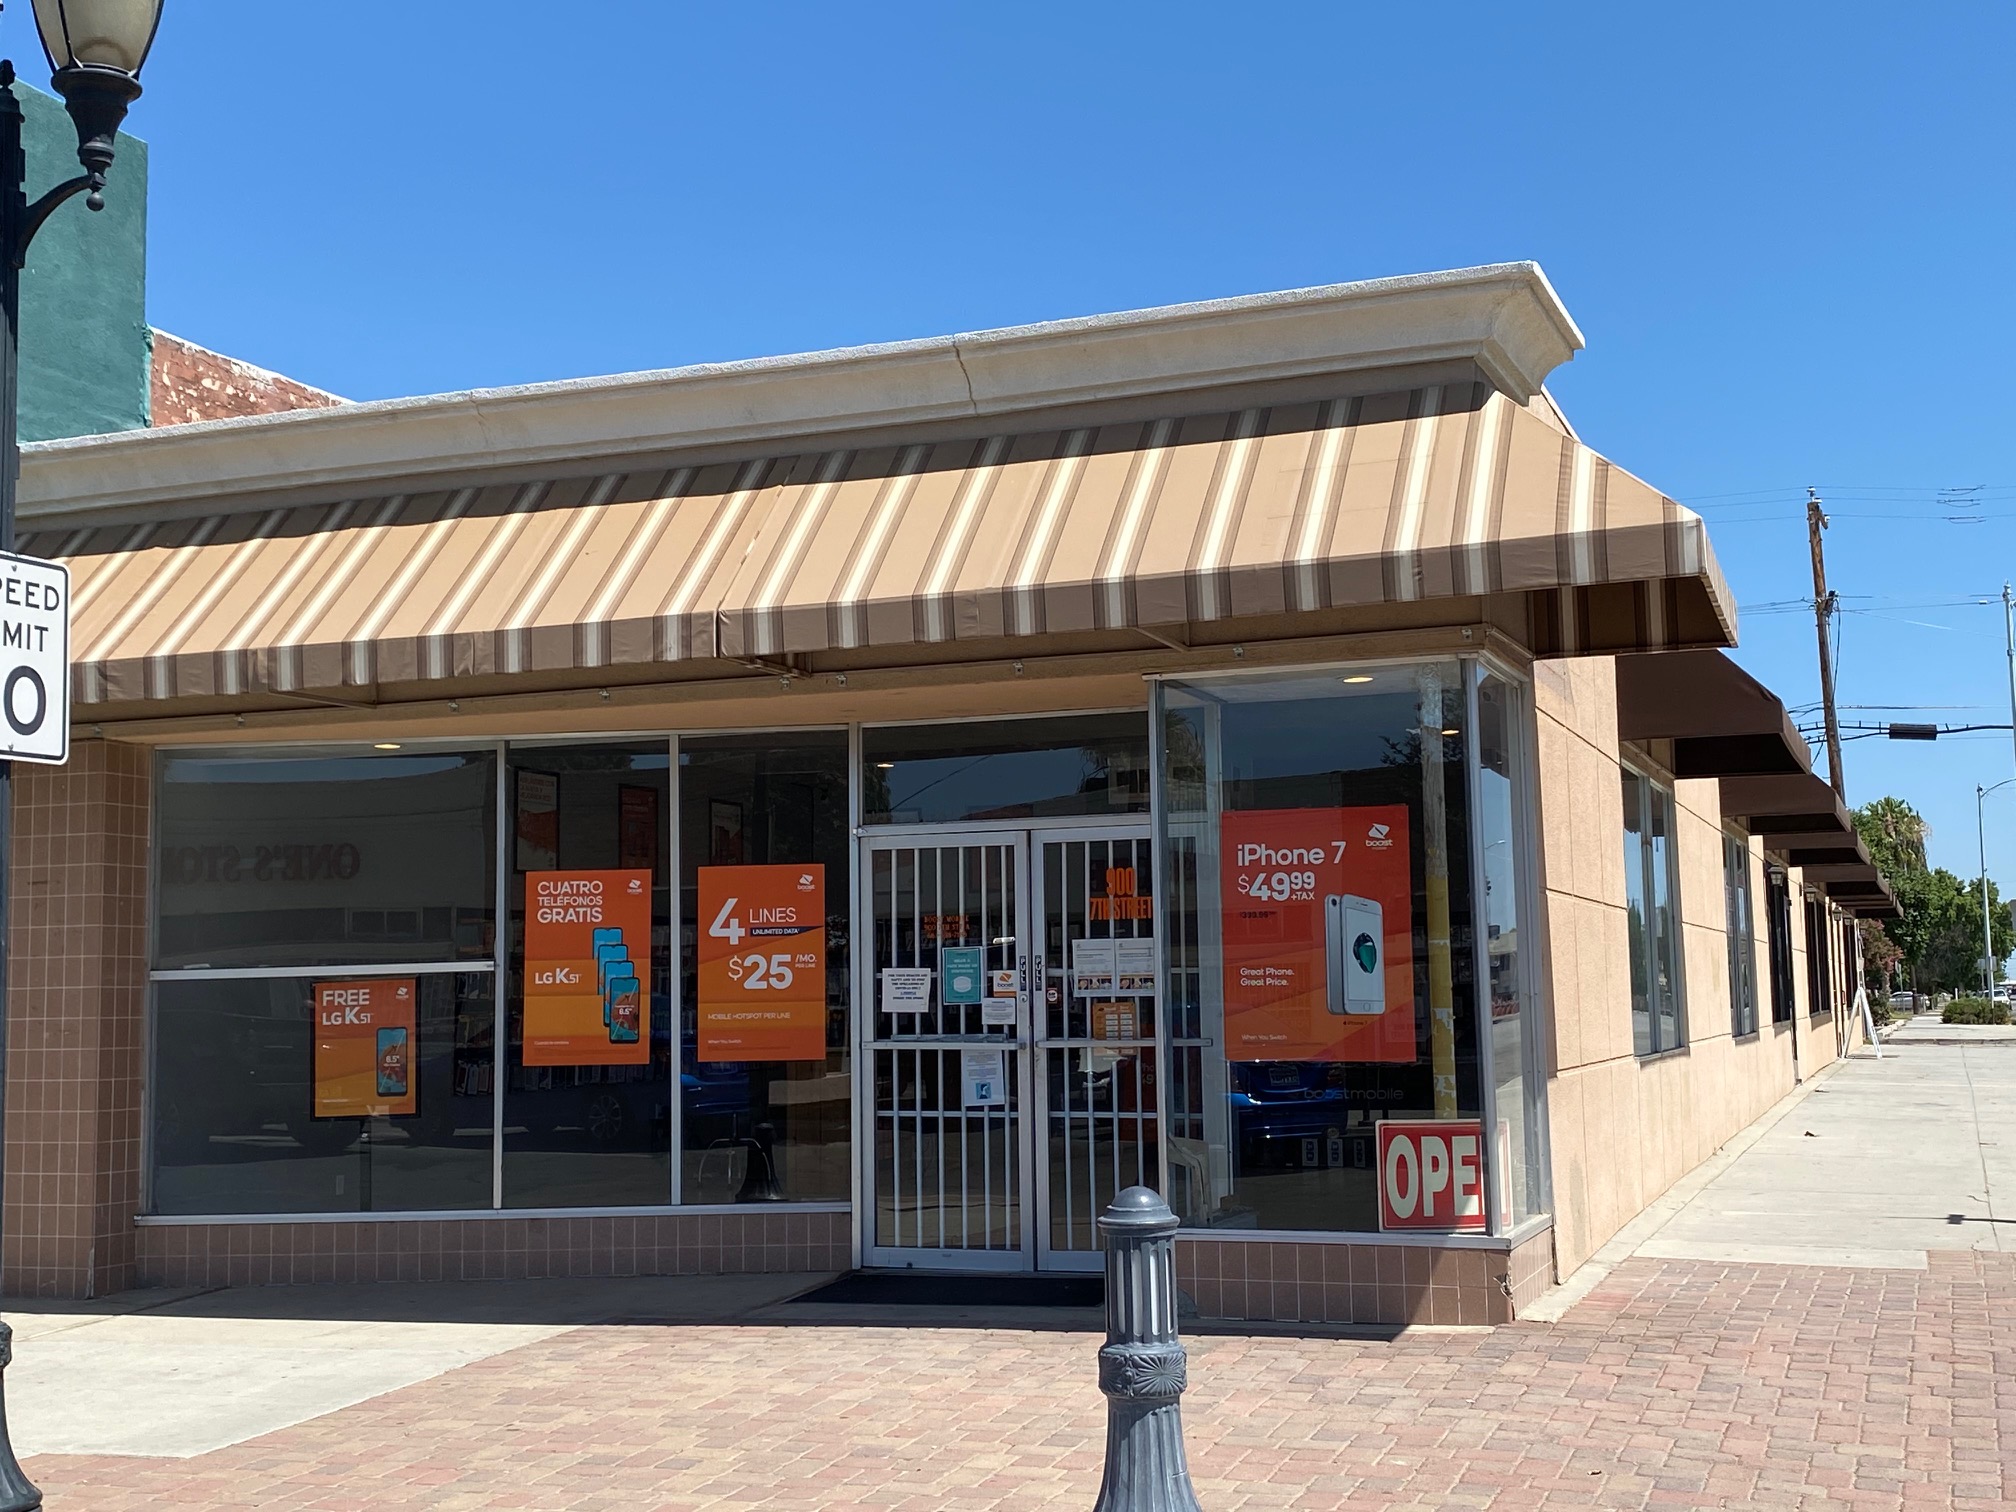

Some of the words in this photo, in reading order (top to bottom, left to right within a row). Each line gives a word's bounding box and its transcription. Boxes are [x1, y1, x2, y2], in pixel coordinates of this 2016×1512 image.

[0, 576, 59, 611] EED
[1365, 838, 1393, 847] boost
[1237, 843, 1325, 866] iPhone
[1331, 841, 1347, 864] 7
[537, 880, 603, 895] CUATRO
[1106, 867, 1137, 896] 900
[537, 895, 603, 907] TELÉFONOS
[537, 907, 603, 924] GRATIS
[708, 897, 746, 945] 4
[749, 907, 797, 923] LINES
[534, 971, 554, 984] LG
[728, 954, 794, 990] $25
[1240, 967, 1264, 976] Great
[1265, 967, 1295, 976] Phone.
[1240, 977, 1264, 986] Great
[1265, 977, 1289, 986] Price.
[322, 988, 370, 1006] FREE
[322, 1012, 342, 1025] LG
